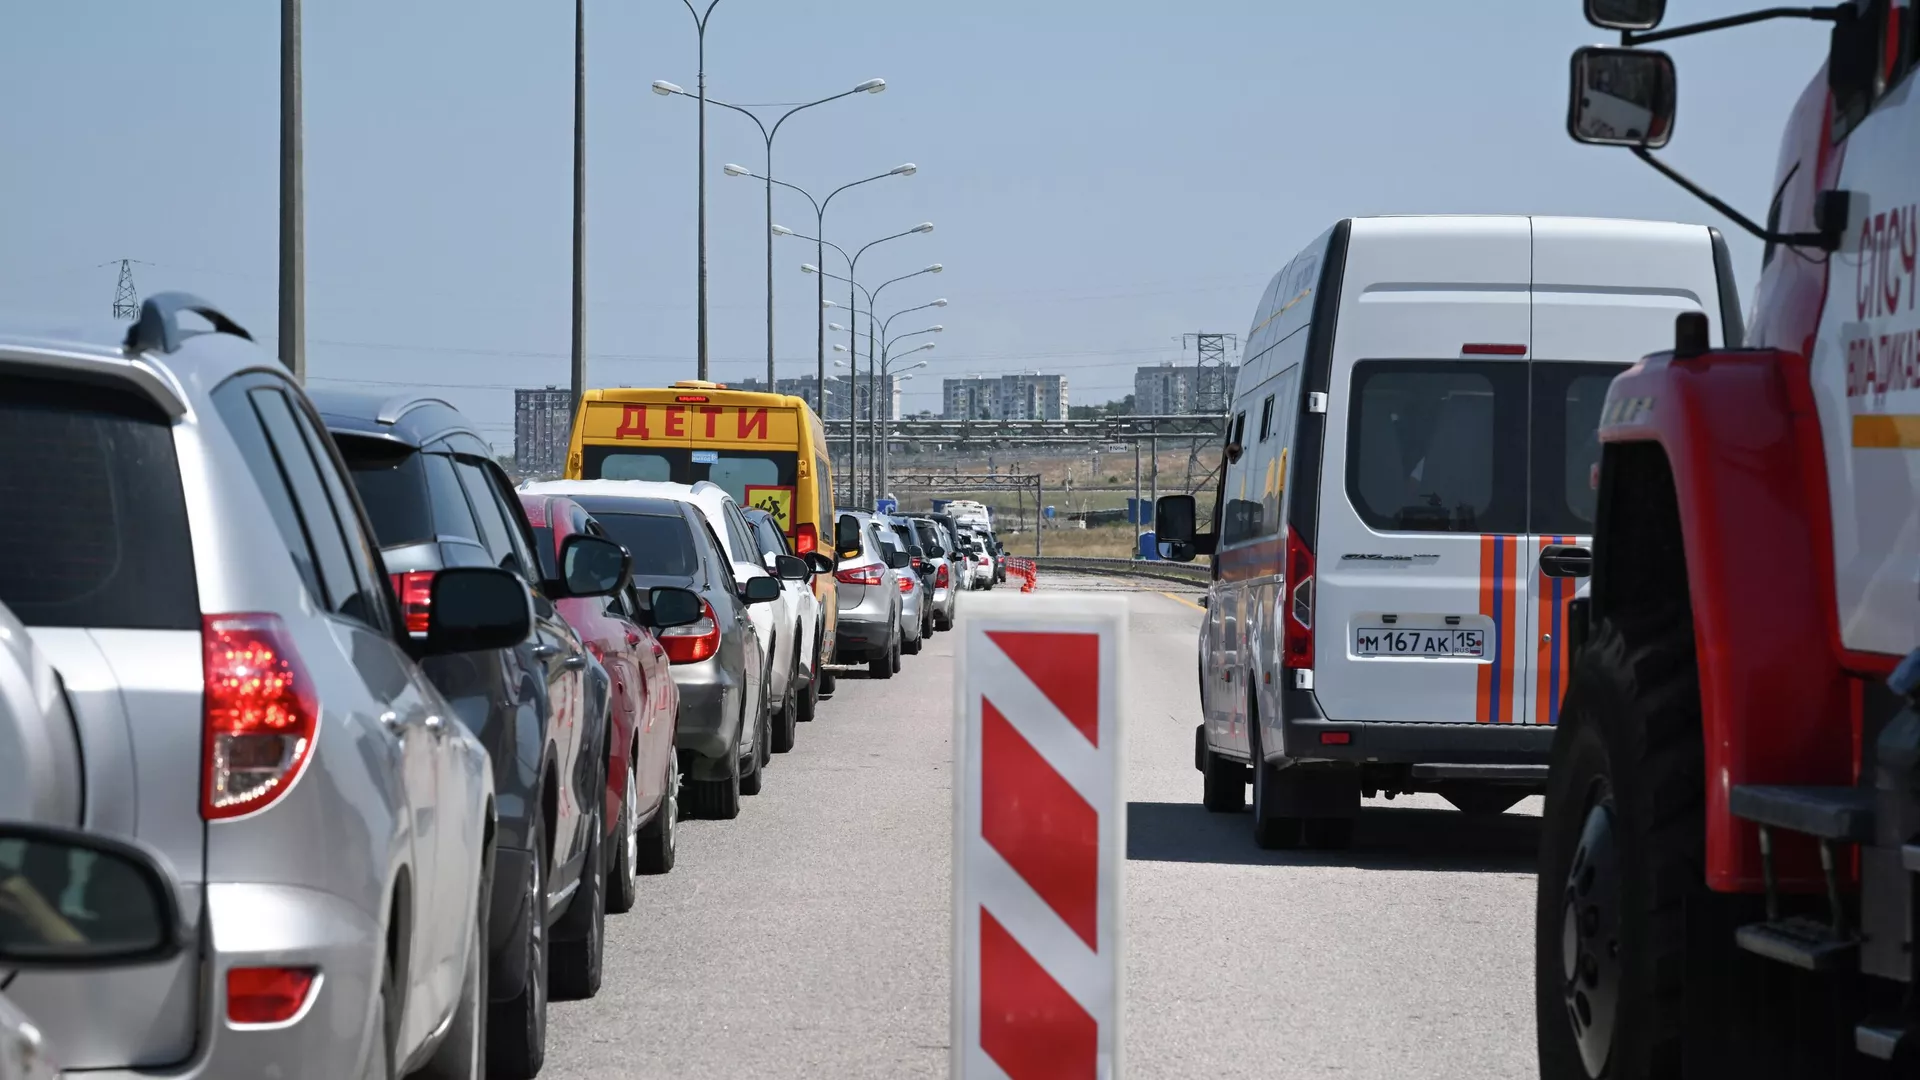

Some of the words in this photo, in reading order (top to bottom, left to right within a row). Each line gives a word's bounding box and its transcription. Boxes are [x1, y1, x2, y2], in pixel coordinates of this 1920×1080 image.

[1856, 204, 1917, 322] СПСЧ
[615, 404, 768, 440] ДЕТИ
[1456, 632, 1476, 648] 15
